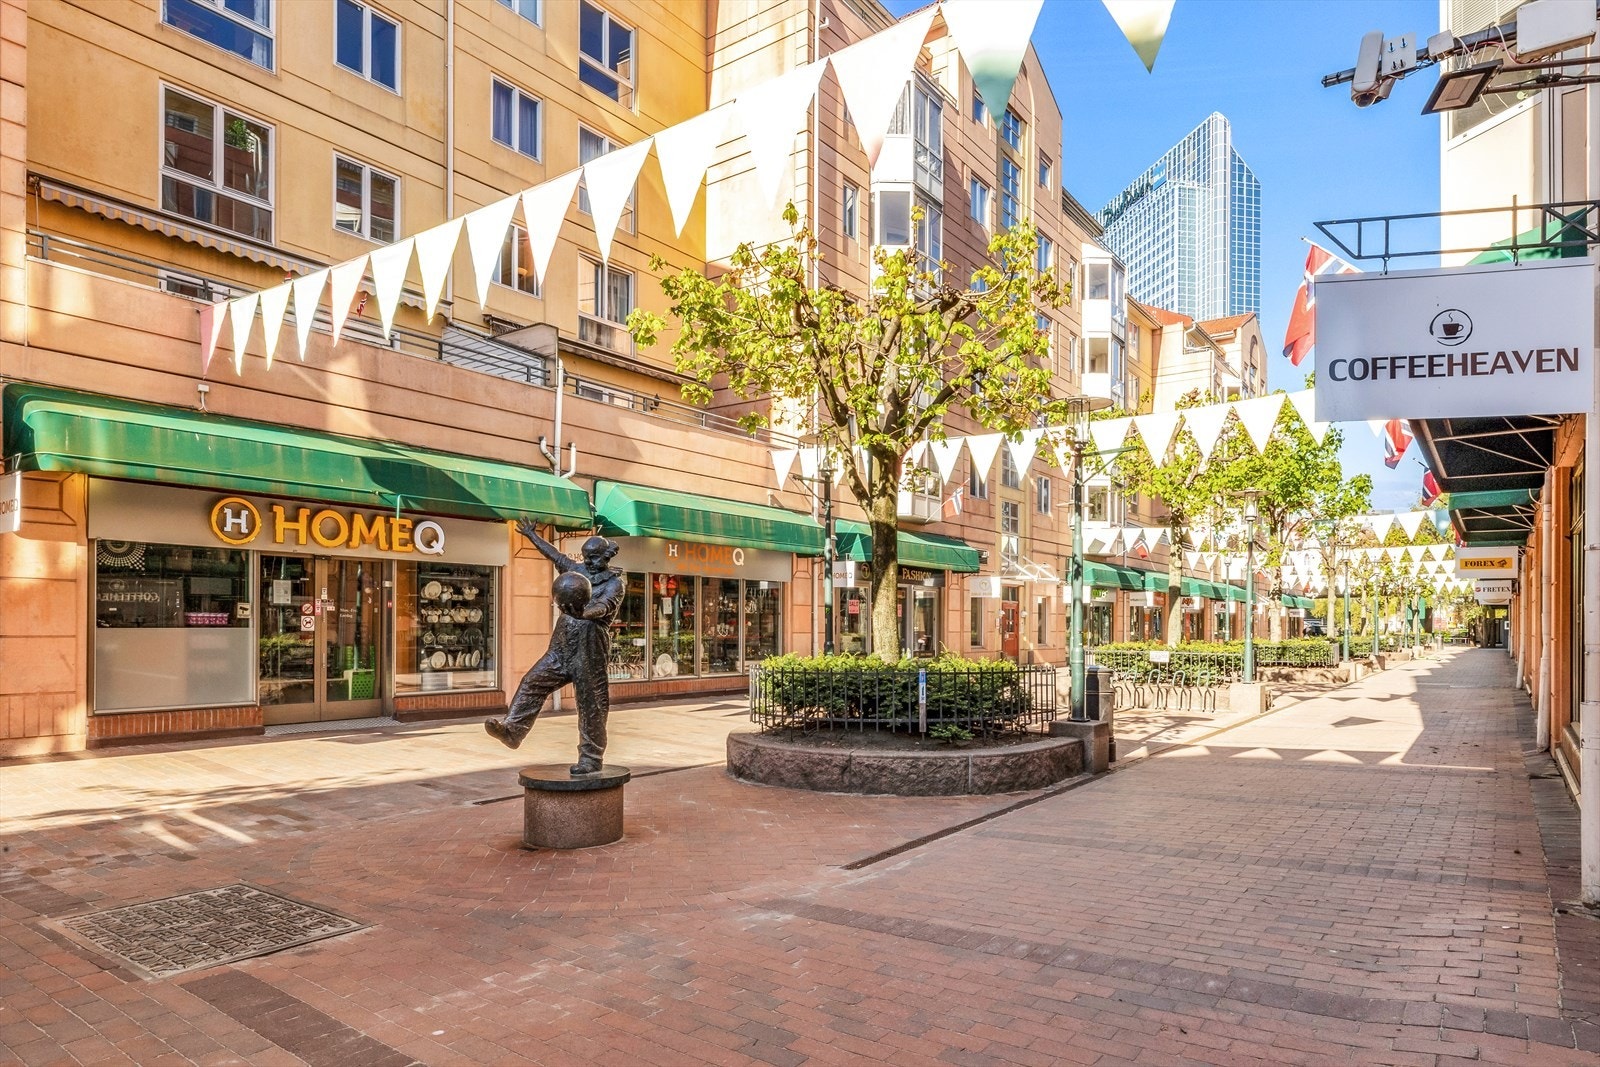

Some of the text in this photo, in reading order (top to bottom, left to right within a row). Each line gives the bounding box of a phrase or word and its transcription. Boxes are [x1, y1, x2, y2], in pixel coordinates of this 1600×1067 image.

[1328, 347, 1579, 382] COFFEEHEAVEN
[0, 498, 19, 515] OMEQ
[270, 503, 446, 557] HOMEQ
[684, 542, 745, 566] HOMEQ
[1464, 559, 1496, 568] FOREX
[902, 567, 933, 581] FASHION
